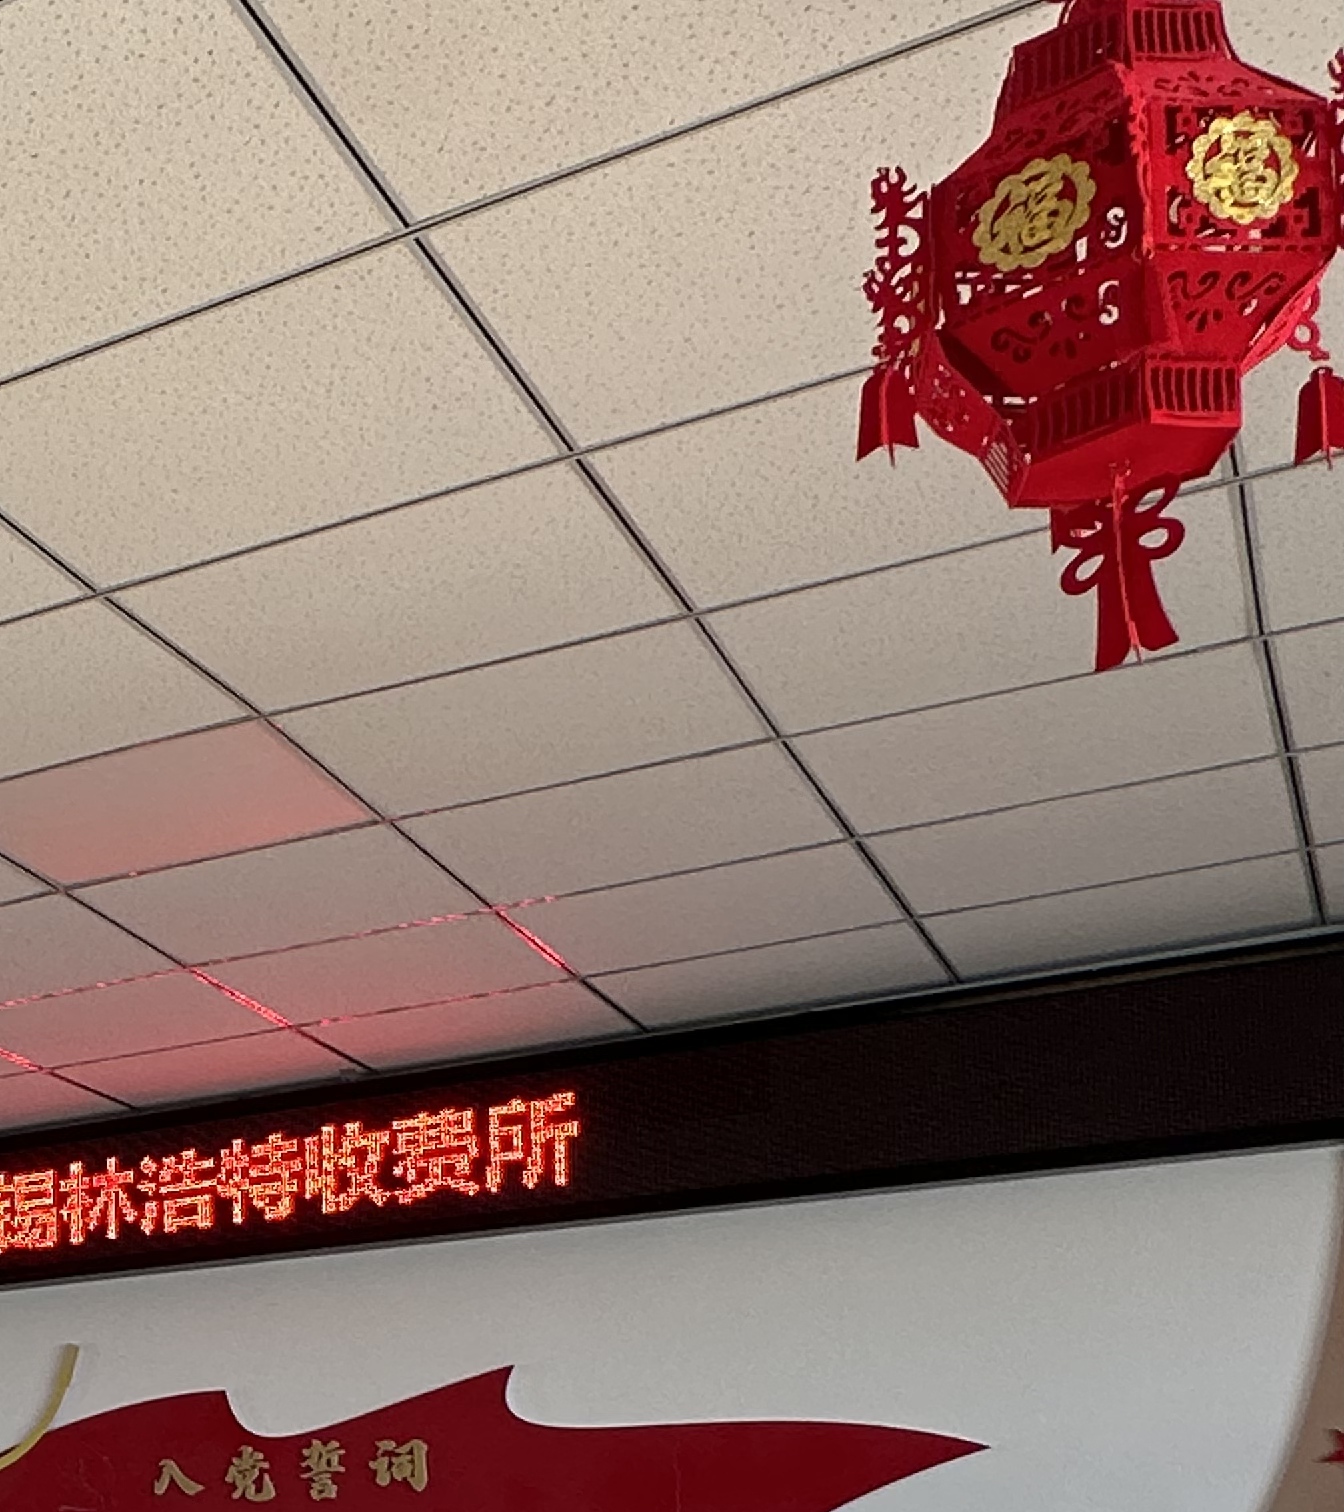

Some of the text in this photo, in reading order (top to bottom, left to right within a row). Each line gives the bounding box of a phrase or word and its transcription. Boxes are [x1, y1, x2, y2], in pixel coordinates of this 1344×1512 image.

[984, 162, 1086, 262] 福
[1196, 120, 1289, 215] 福
[154, 1438, 428, 1502] 入党誓词
